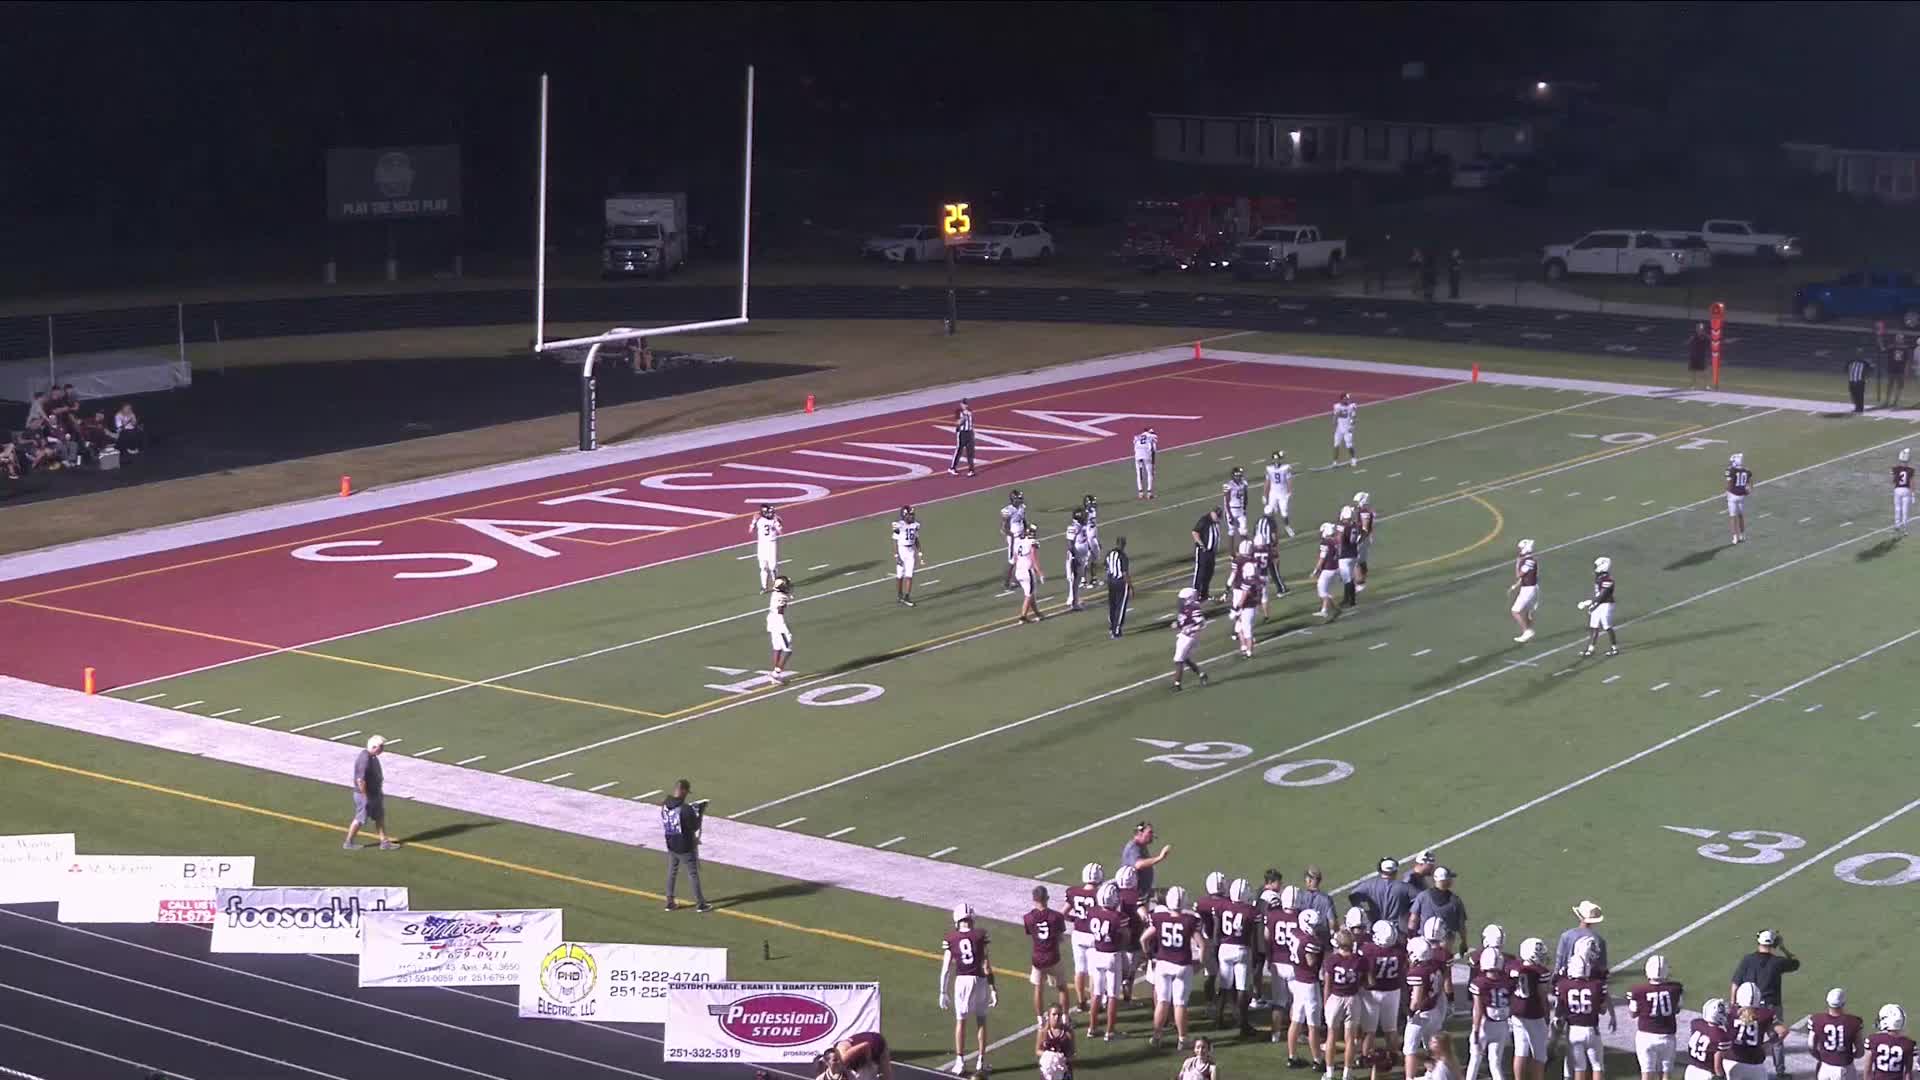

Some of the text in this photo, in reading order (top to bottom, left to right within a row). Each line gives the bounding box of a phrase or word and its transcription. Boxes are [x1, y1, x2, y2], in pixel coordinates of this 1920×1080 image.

[944, 203, 970, 234] 25
[1273, 472, 1281, 484] 9
[1736, 471, 1747, 487] 10
[1899, 471, 1907, 485] 3
[289, 411, 1202, 580] SATSUMA
[1161, 921, 1184, 948] 56
[1222, 910, 1243, 937] 64
[958, 938, 974, 965] 8
[610, 970, 710, 983] 251-222-4740
[1376, 956, 1399, 979] 72
[1567, 988, 1592, 1015] 66
[1646, 990, 1672, 1017] 70
[727, 1005, 830, 1025] Professional
[751, 1026, 802, 1037] STONE
[670, 1049, 741, 1058] 251-332-5319
[1876, 1044, 1903, 1074] 22
